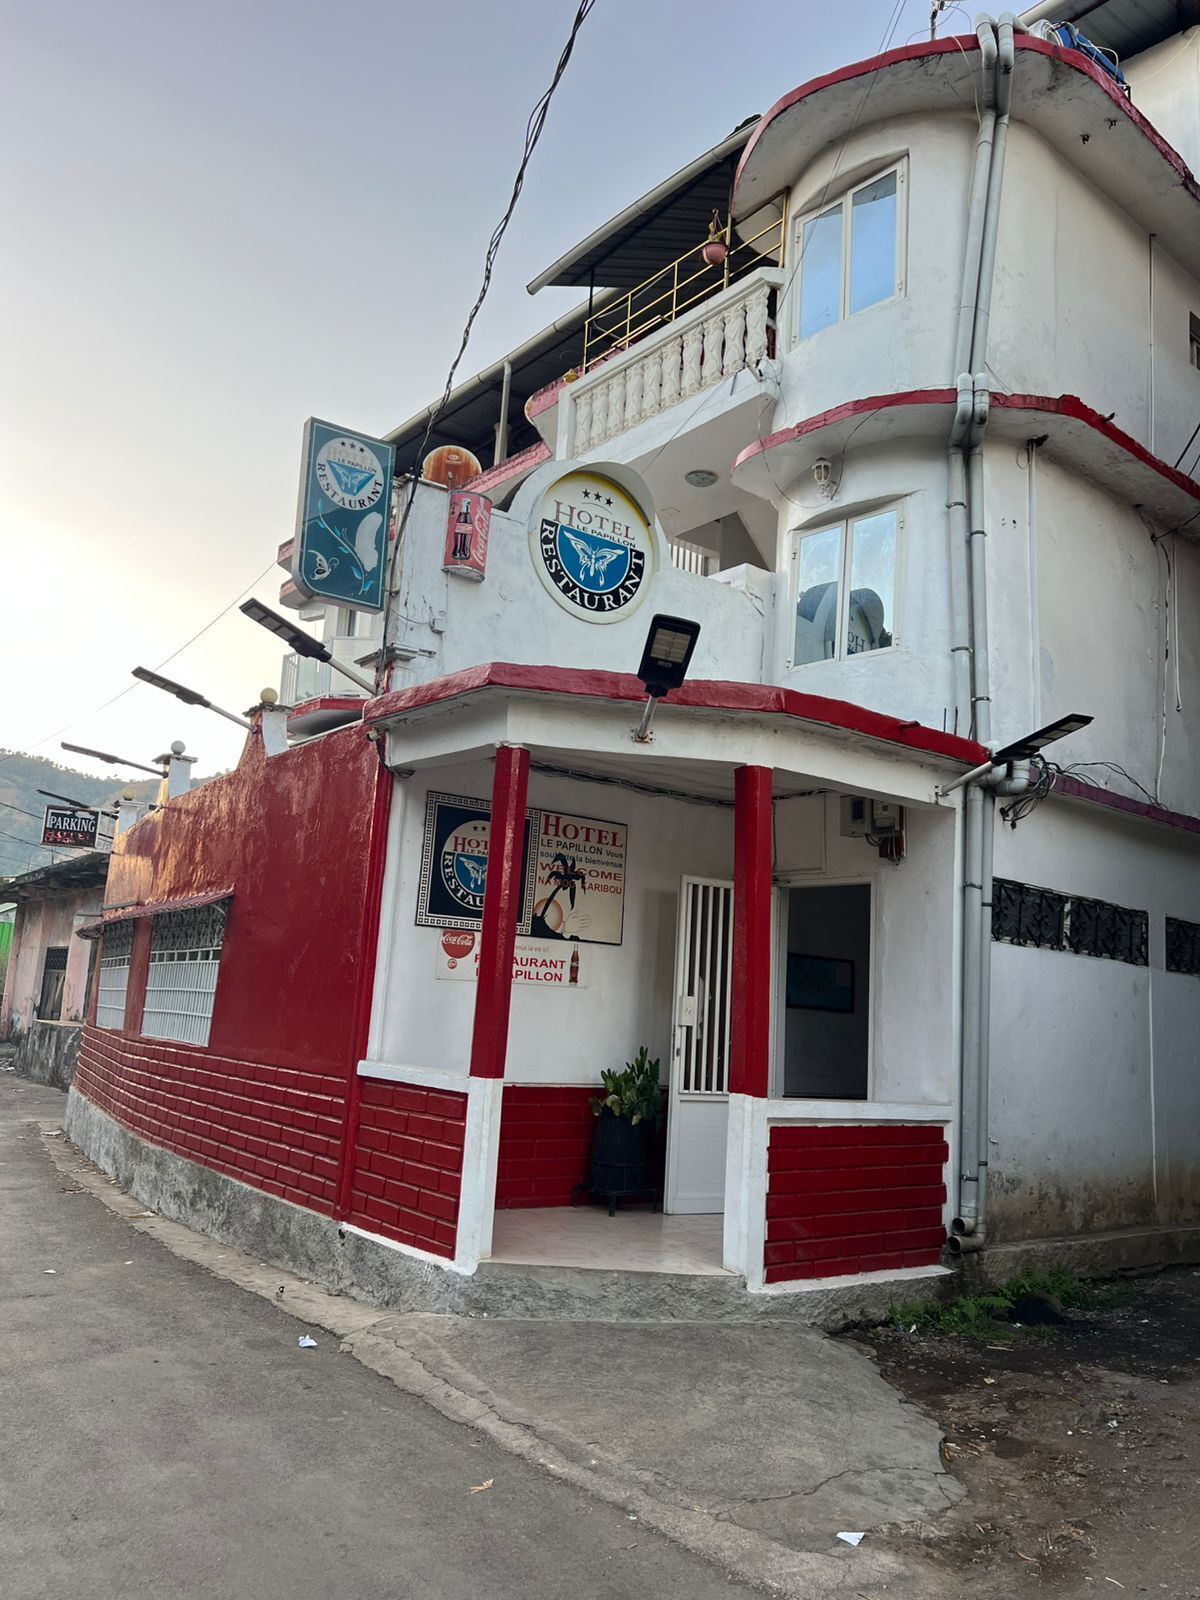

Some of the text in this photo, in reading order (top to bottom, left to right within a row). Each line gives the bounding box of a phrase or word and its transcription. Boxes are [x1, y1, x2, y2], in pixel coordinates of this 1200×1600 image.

[317, 462, 383, 509] RESTAURANT
[553, 499, 635, 541] HOTEL
[576, 524, 636, 549] LE PAPILLON
[541, 522, 644, 611] RESTAURANT
[49, 816, 96, 833] PARKING
[542, 813, 623, 848] HOTEL
[452, 835, 490, 853] HOT
[541, 838, 624, 859] LE PAPILLON Vous
[585, 856, 623, 869] bienvenue
[444, 854, 485, 906] RESTAU
[511, 969, 563, 982] PILLON
